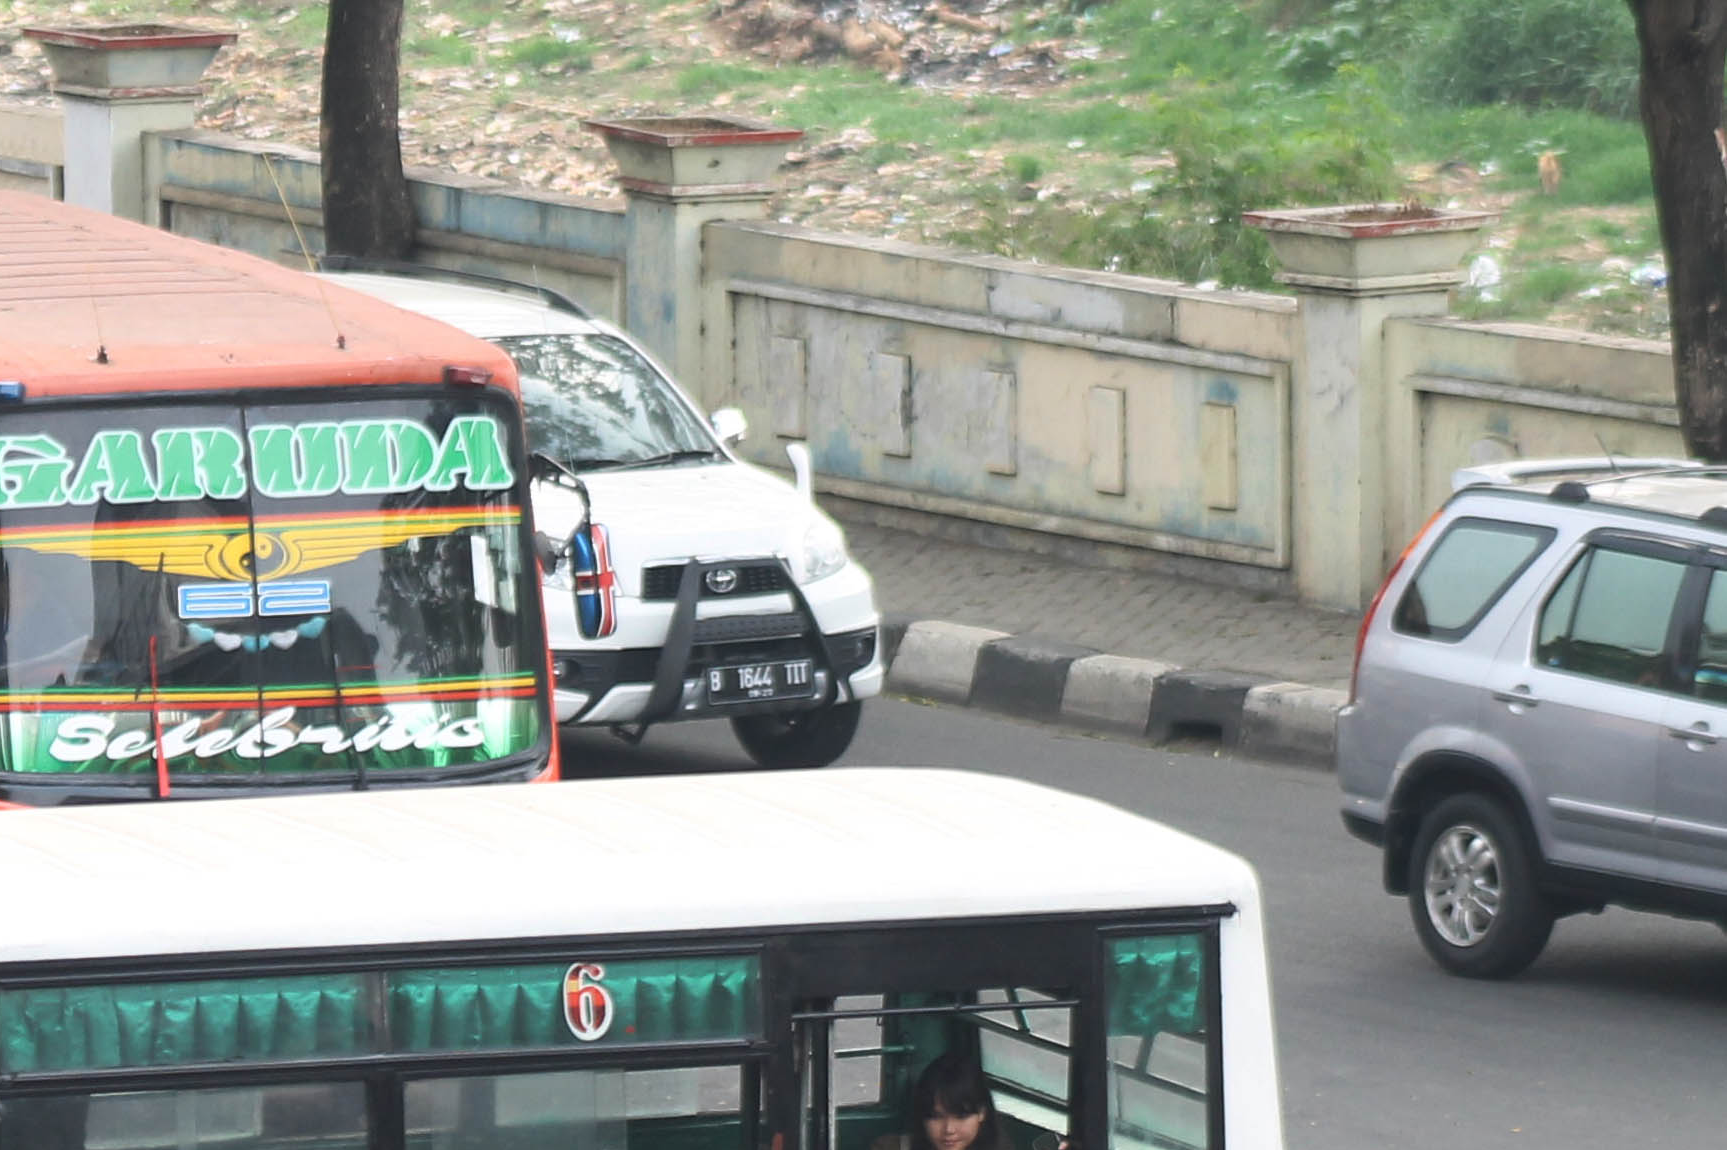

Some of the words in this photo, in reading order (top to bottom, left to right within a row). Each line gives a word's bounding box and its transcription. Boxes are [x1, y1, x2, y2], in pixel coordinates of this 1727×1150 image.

[178, 580, 332, 620] 62
[710, 670, 722, 692] B
[738, 666, 772, 689] 1644
[563, 962, 614, 1041] 6
